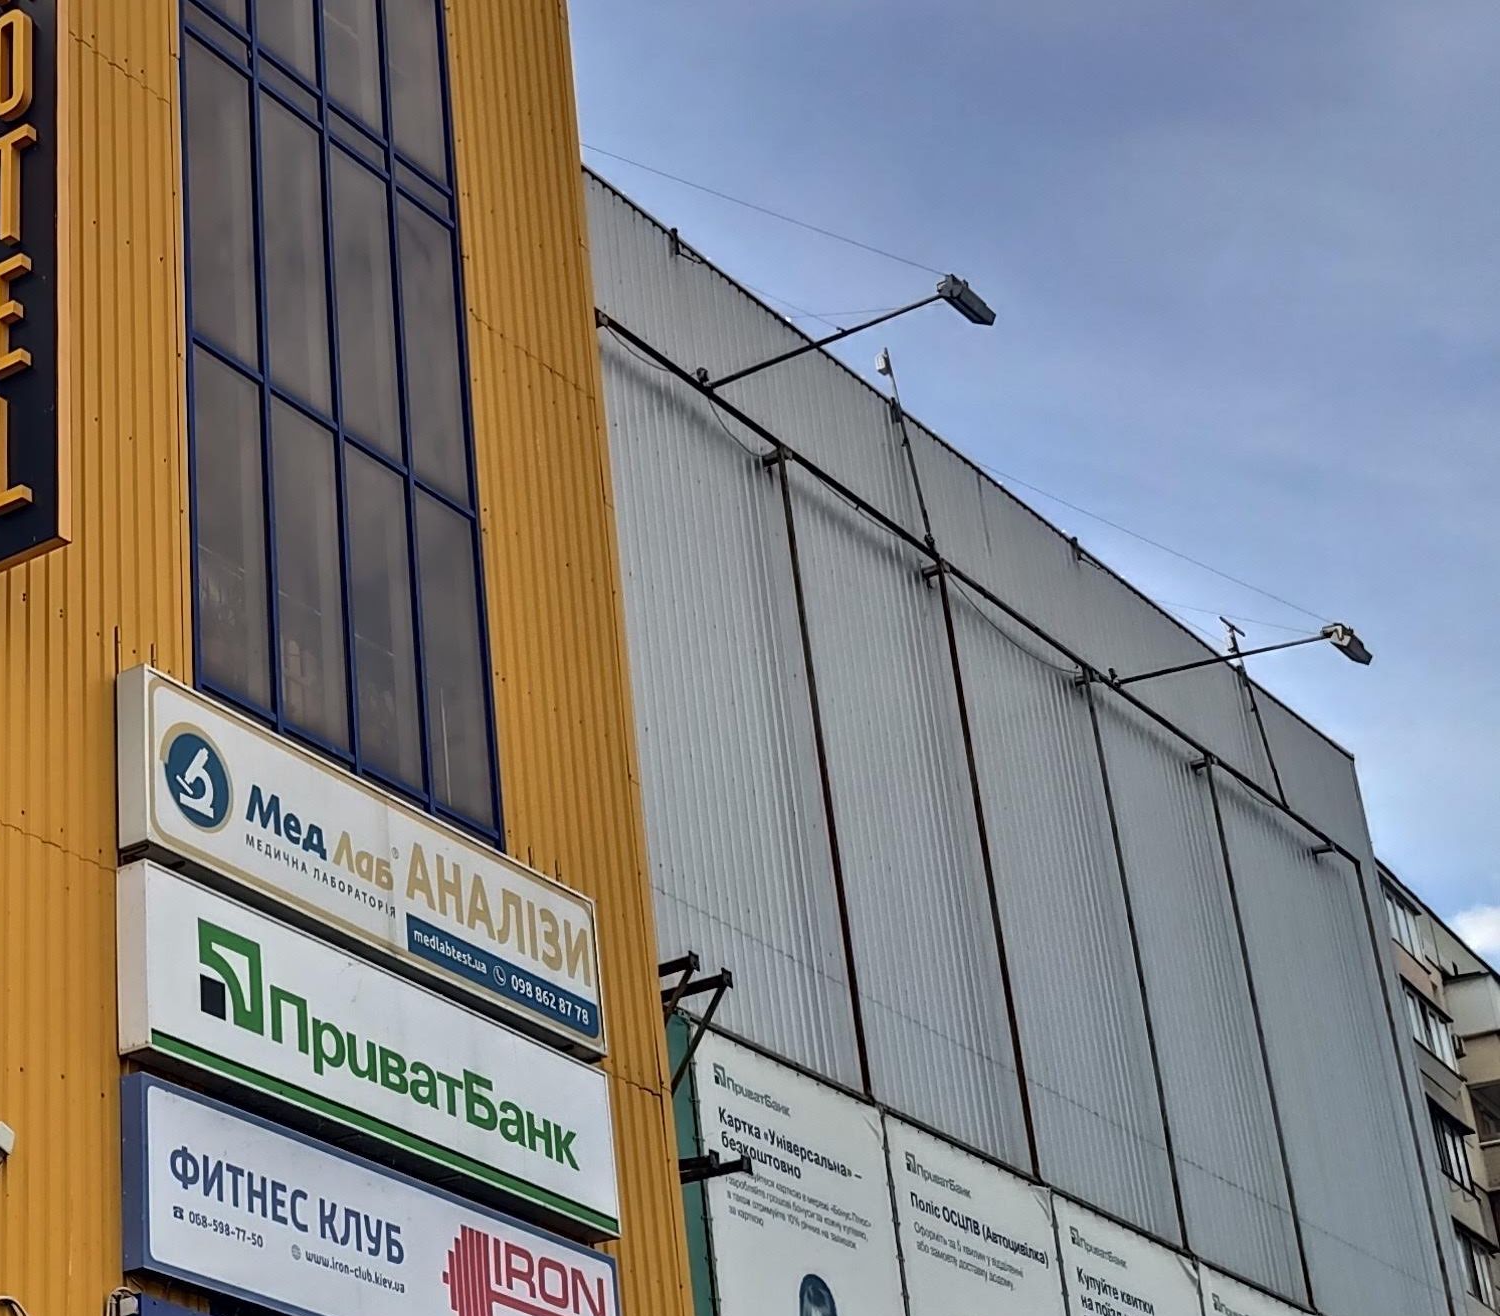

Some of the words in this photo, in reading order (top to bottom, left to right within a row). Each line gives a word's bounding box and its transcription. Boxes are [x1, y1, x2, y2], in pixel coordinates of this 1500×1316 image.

[245, 834, 309, 878] МЕДИЧНА
[312, 868, 397, 919] ЛАБОРАТОРІЯ
[406, 842, 593, 988] АНАЛІЗИ
[413, 928, 489, 974] medlabtest.ua
[510, 973, 534, 999] 098
[535, 983, 558, 1010] 862
[558, 993, 575, 1018] 87
[575, 1001, 590, 1027] 78
[269, 984, 581, 1172] ПриватБанк
[726, 1077, 791, 1117] ПриватБанк
[718, 1107, 761, 1140] Картка
[763, 1130, 853, 1179] «Універсальна»
[721, 1132, 802, 1179] безкоштовно
[169, 1144, 309, 1233] ФИТНЕС
[319, 1197, 405, 1265] КЛУБ
[910, 1192, 941, 1219] Поліс
[188, 1210, 264, 1250] 068-598-77-50
[305, 1247, 405, 1294] www.iron-club.kiev.ua
[1076, 1267, 1118, 1300] Купуйте
[1120, 1290, 1155, 1316] квитки
[1081, 1295, 1094, 1311] на
